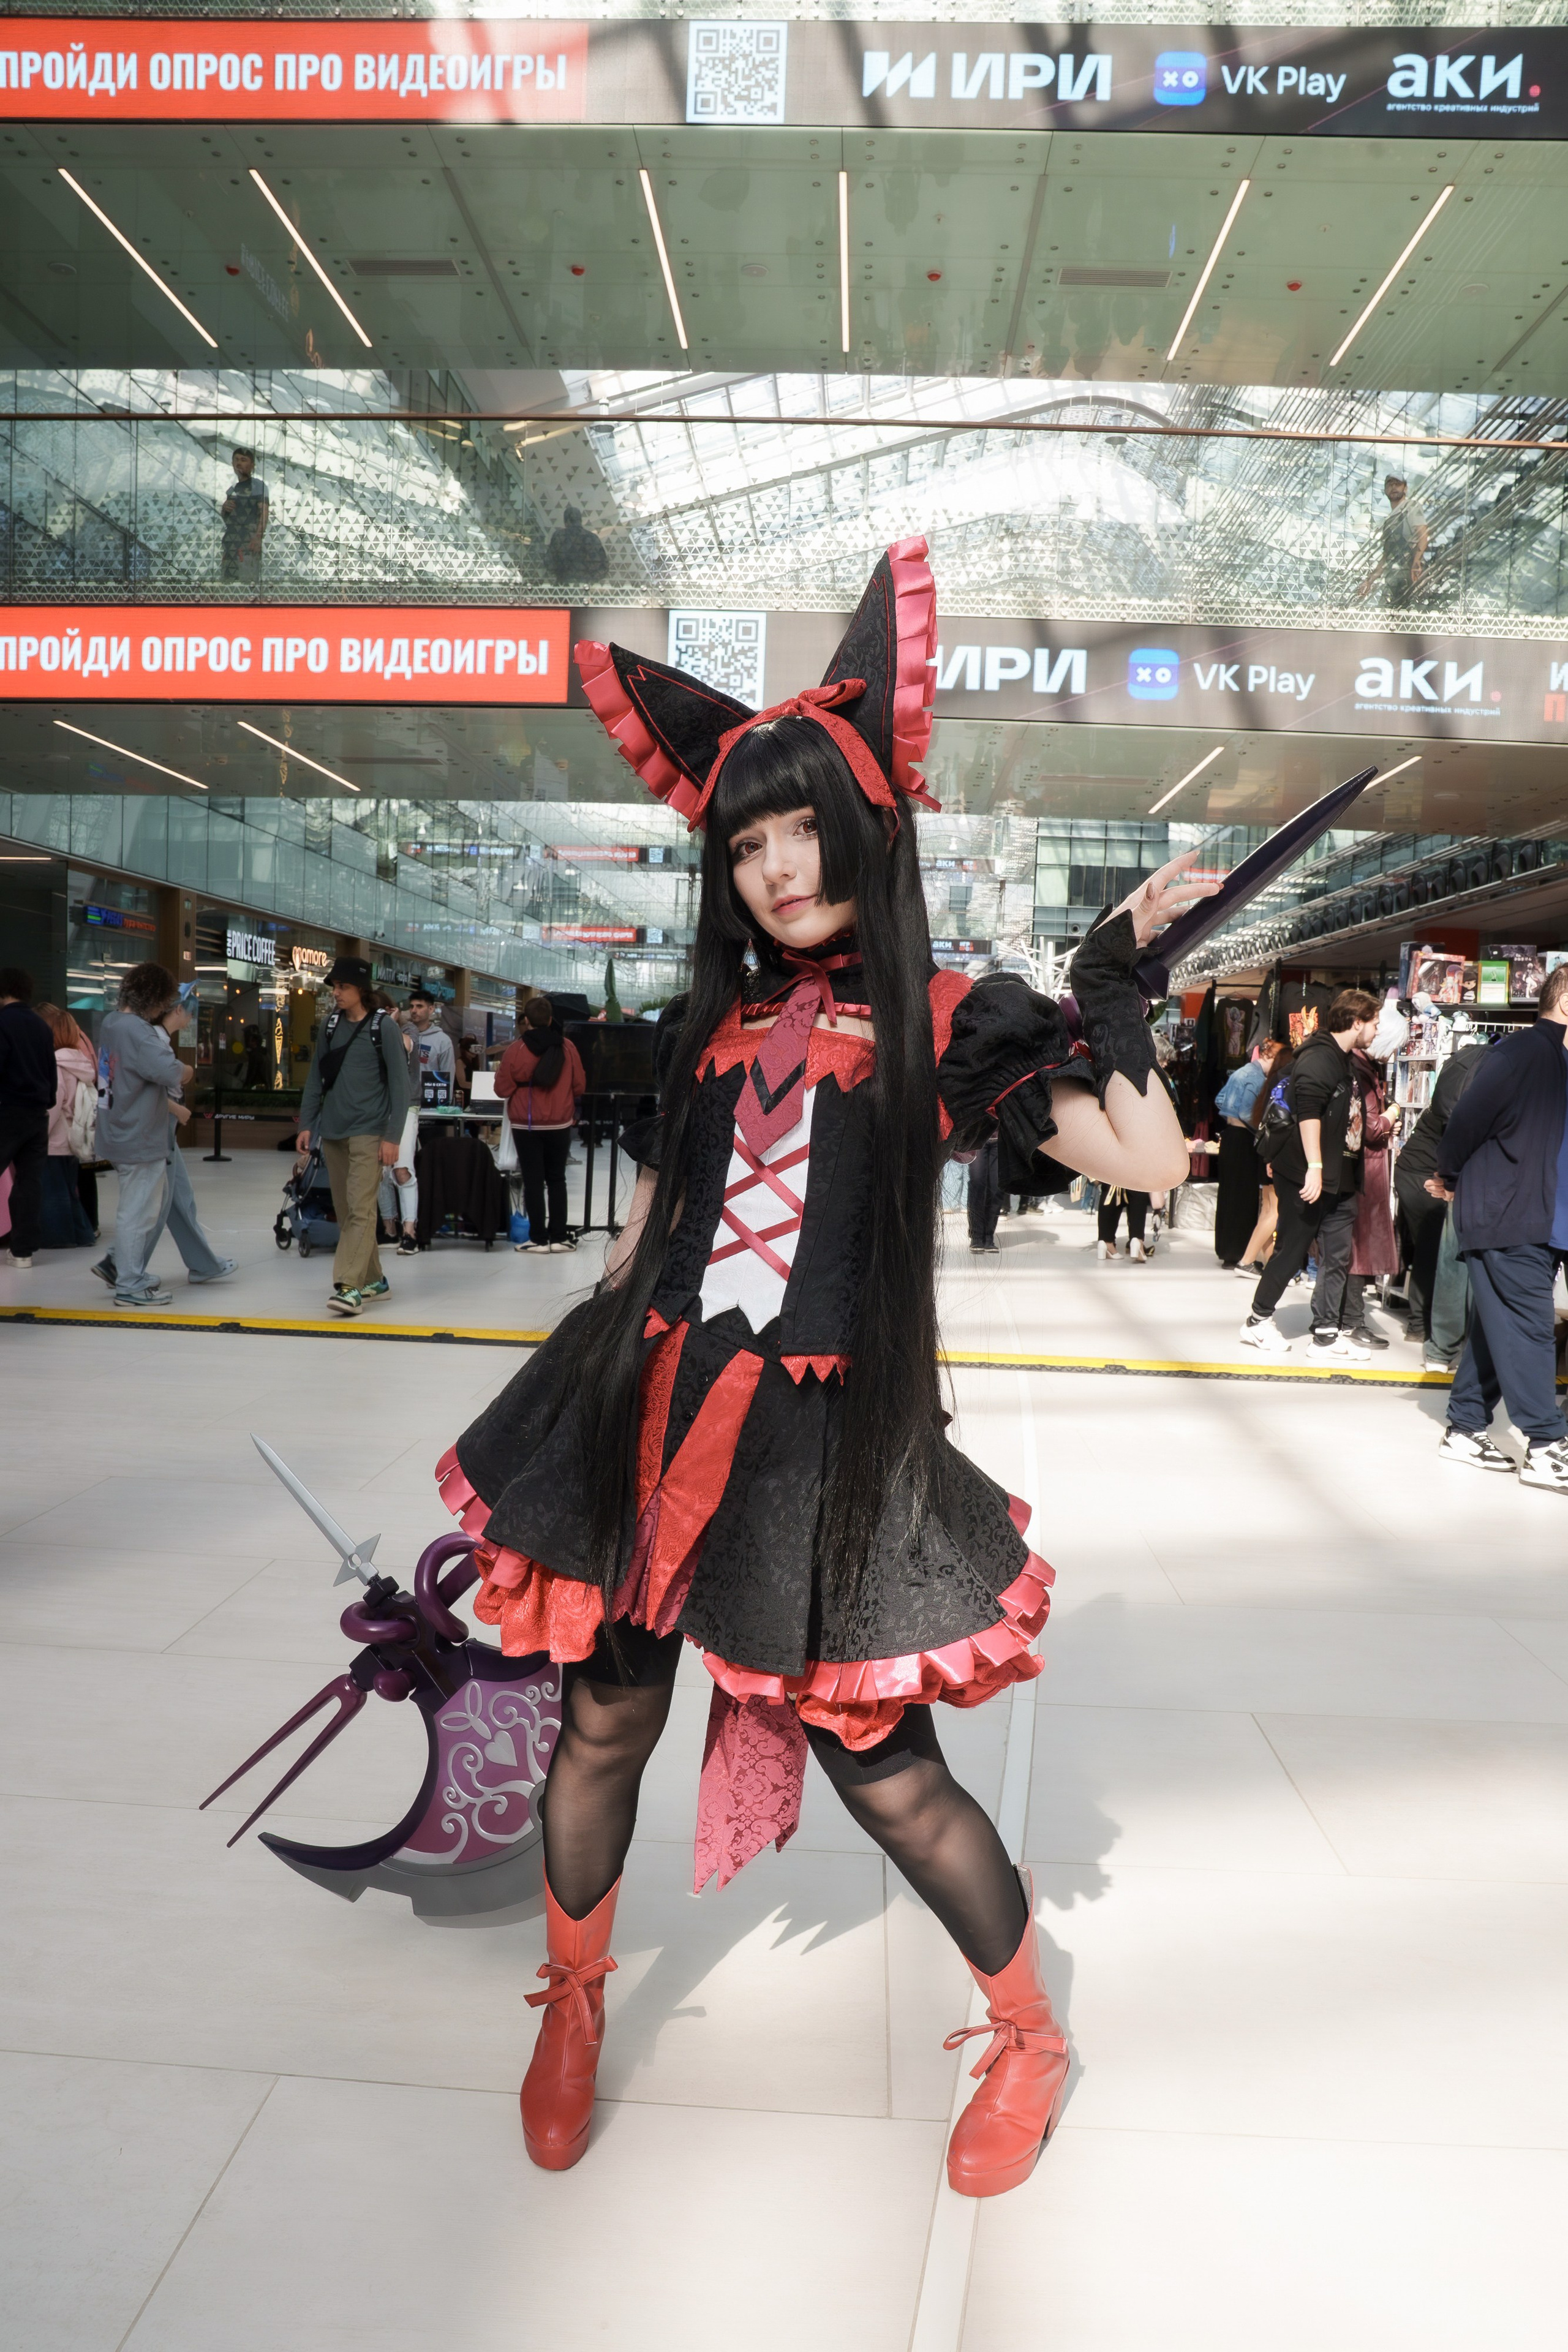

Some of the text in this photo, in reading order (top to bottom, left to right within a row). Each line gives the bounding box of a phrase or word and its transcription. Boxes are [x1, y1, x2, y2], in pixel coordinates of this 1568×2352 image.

[0, 43, 567, 98] ПРОЙДИ ОПРОС ПРО ВИДЕОИГРЫ
[951, 52, 1112, 101] ИРИ
[1221, 66, 1346, 103] VK Play
[1386, 102, 1432, 111] агентство
[0, 628, 548, 680] ПРОЙДИ ОПРОС ПРО ВИДЕОИГРЫ
[1193, 663, 1316, 701] VK Play
[232, 930, 276, 966] PRICE COFFEE
